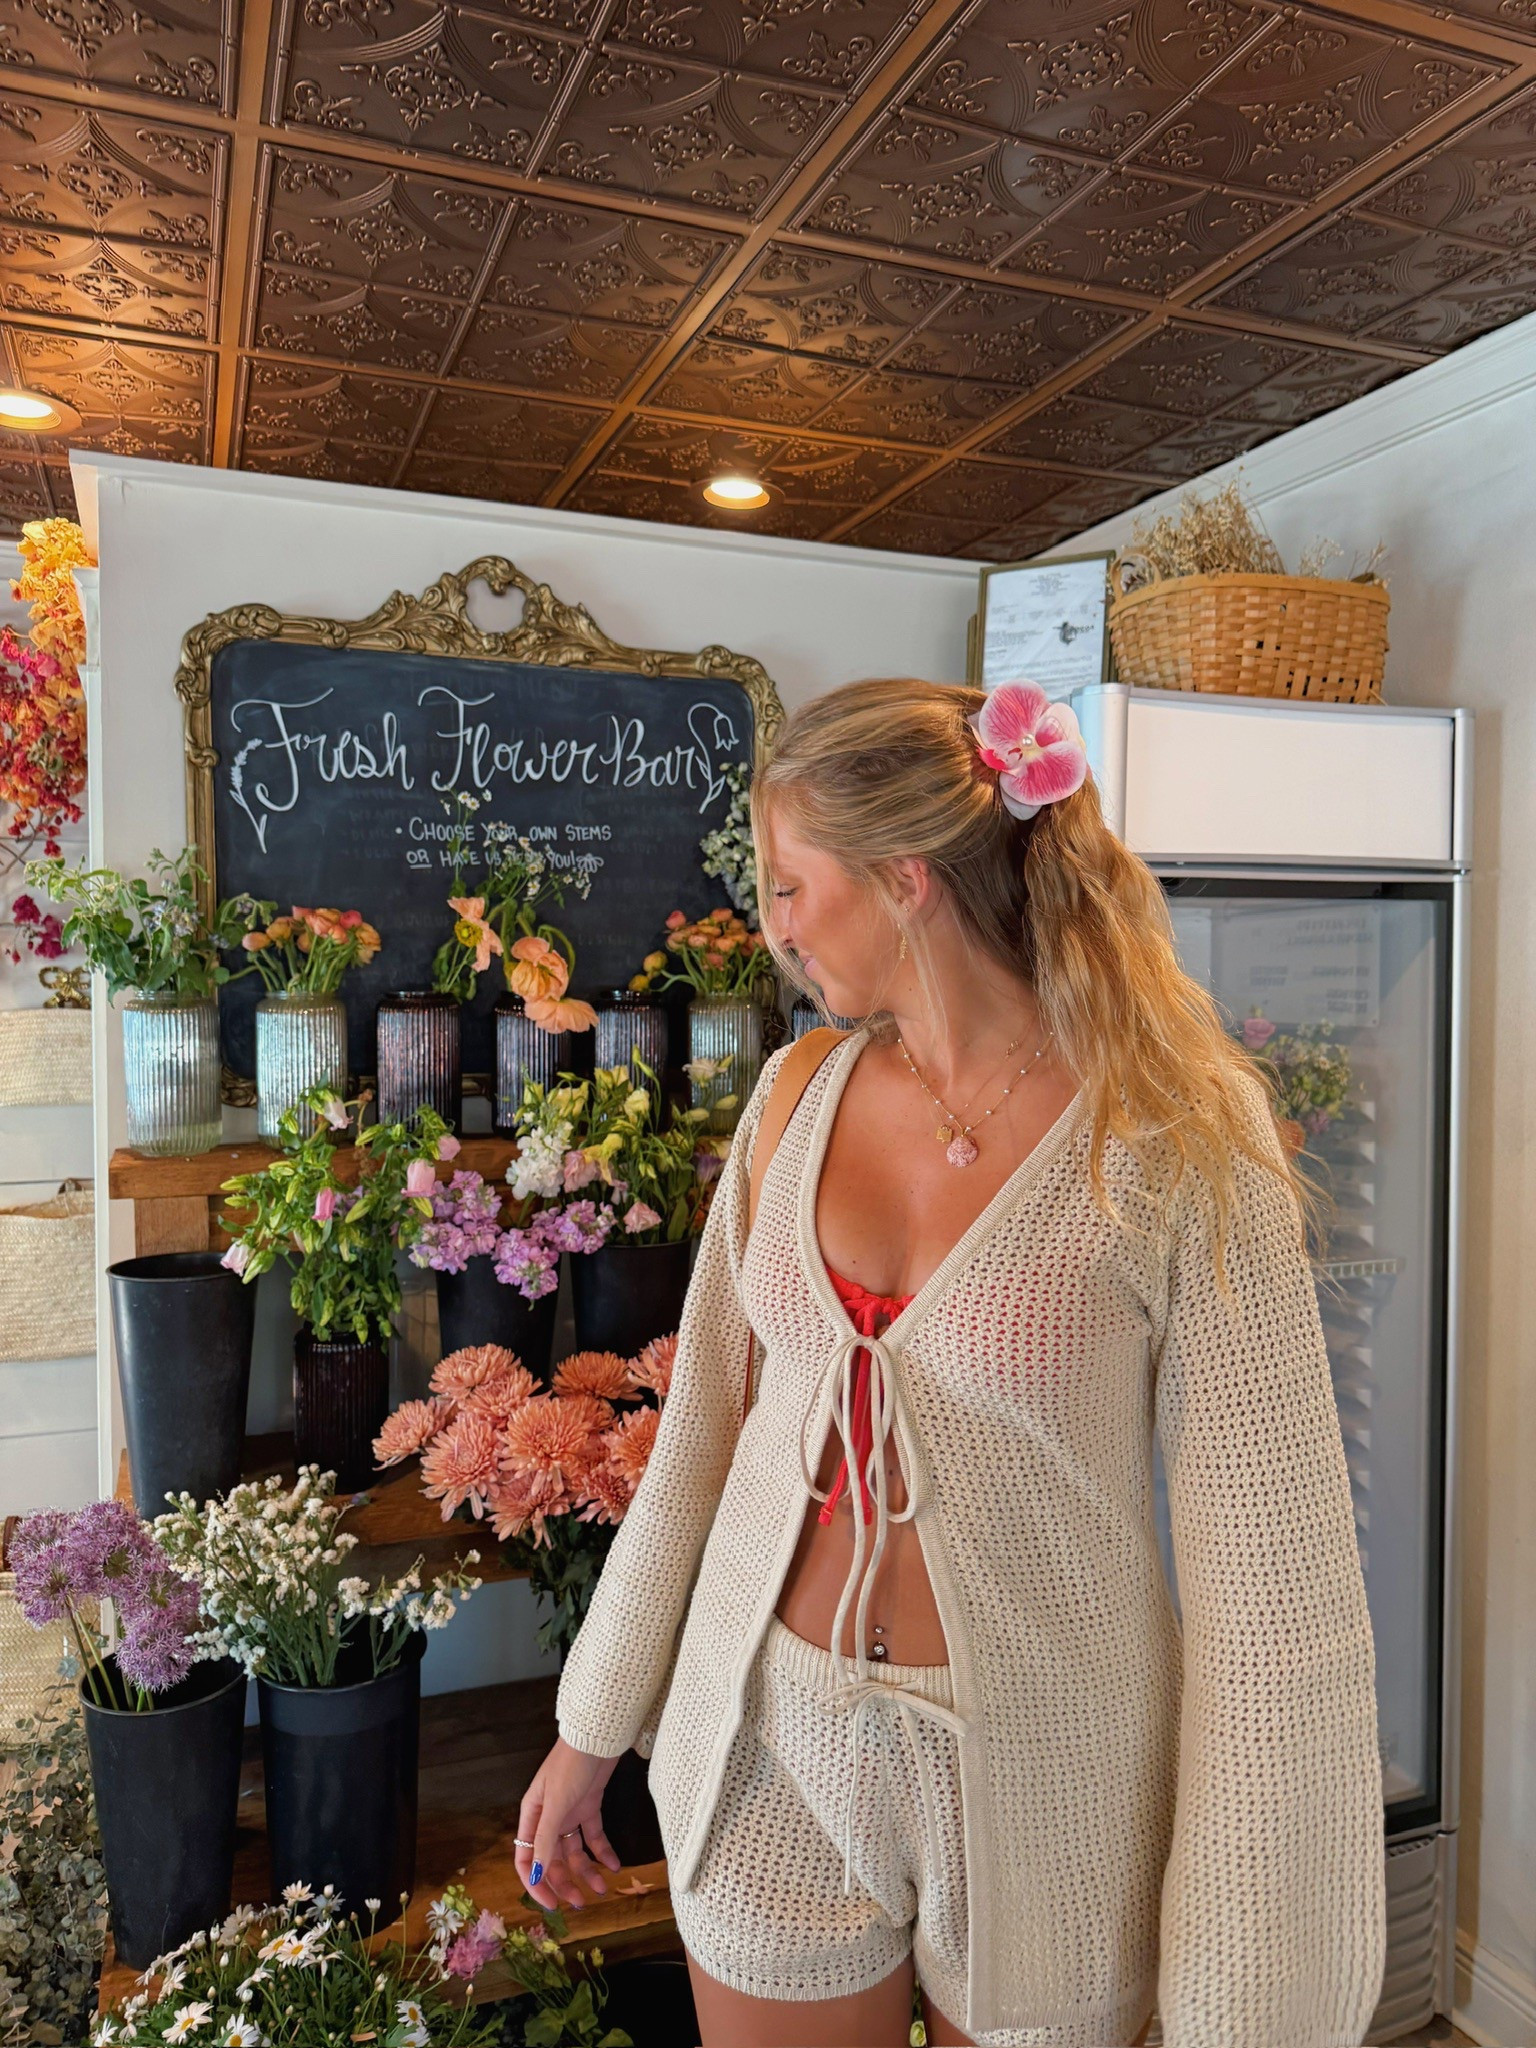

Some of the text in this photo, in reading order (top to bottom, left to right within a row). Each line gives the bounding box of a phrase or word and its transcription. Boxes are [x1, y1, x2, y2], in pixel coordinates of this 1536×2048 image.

[231, 685, 697, 812] Fresh Flower Bar
[408, 815, 476, 842] CHOOSE
[529, 825, 558, 842] OWN
[566, 824, 612, 842] STEMS
[406, 849, 431, 869] OR
